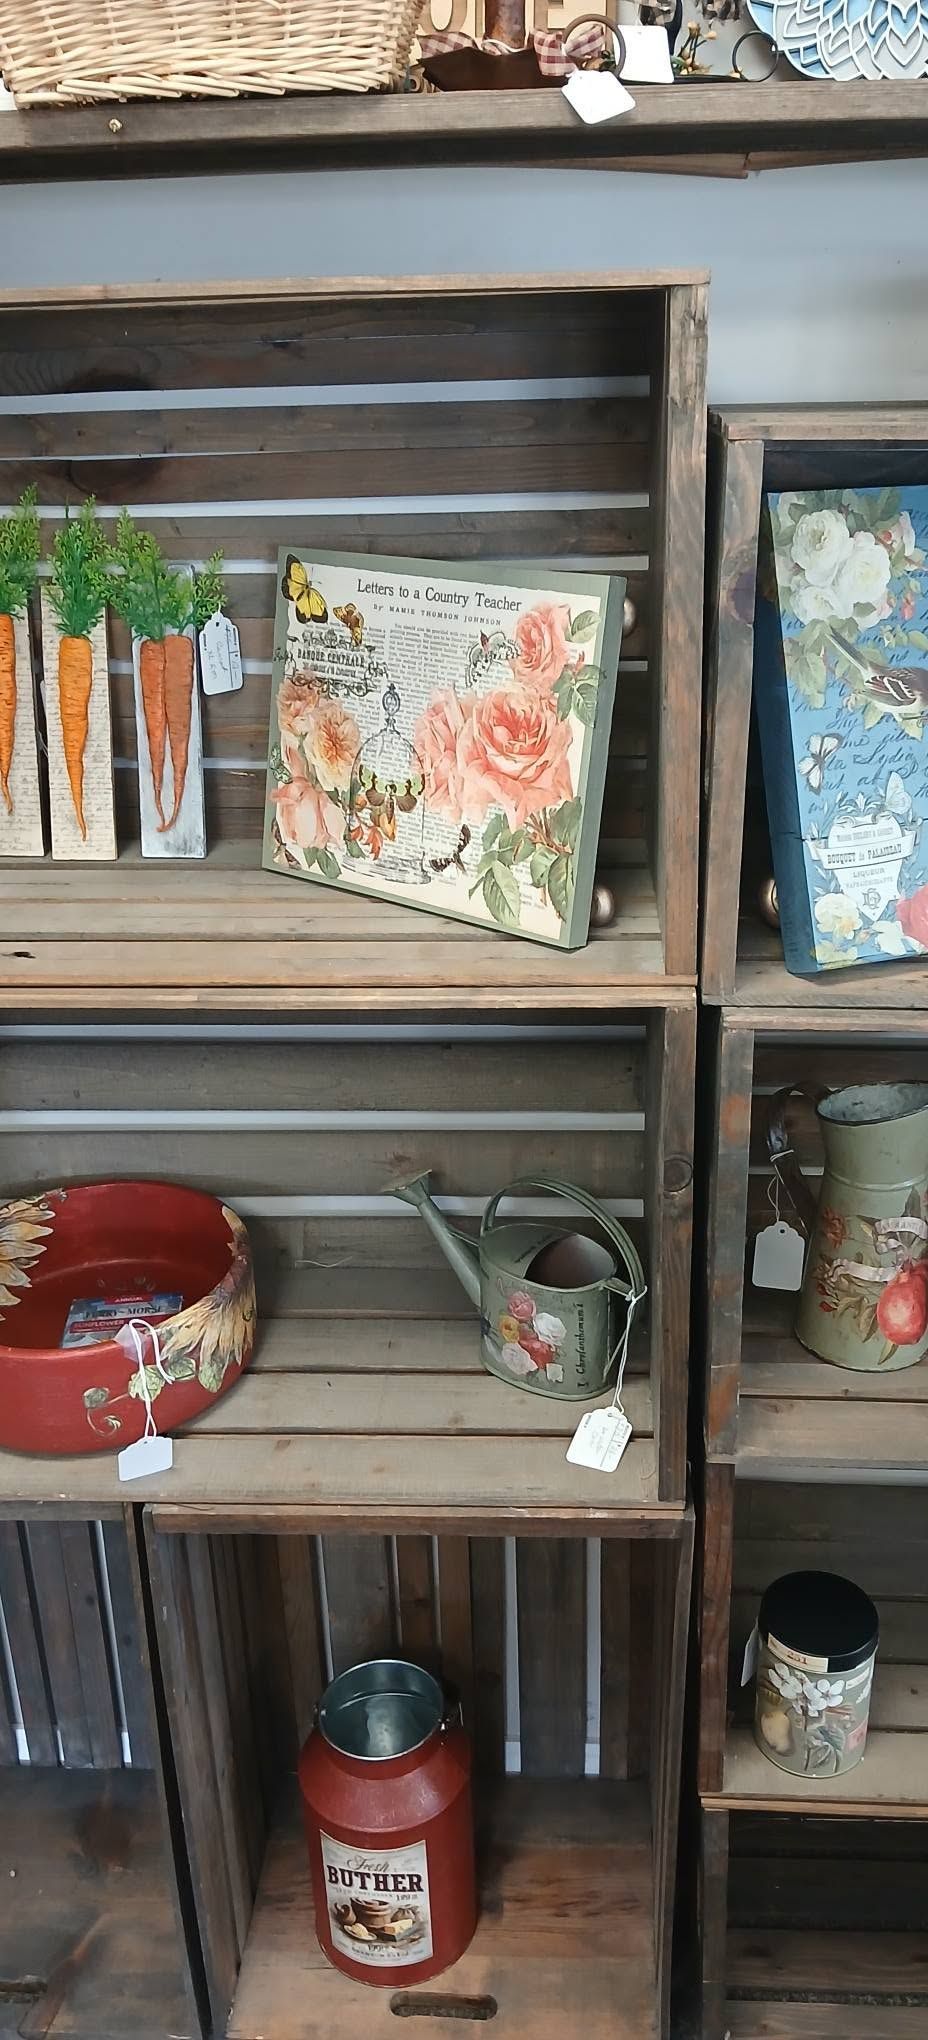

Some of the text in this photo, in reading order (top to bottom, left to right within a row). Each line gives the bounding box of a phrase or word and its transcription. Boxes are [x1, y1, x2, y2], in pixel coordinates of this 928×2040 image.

[357, 578, 522, 612] Letters to a Country Teacher
[389, 606, 415, 615] MAMIE
[421, 610, 459, 620] THOMSON
[463, 615, 502, 626] JOHNSON
[327, 652, 365, 667] CENTRALE
[827, 852, 856, 865] BOUQUET
[346, 1854, 390, 1872] Fresh
[326, 1864, 424, 1893] BUTHER
